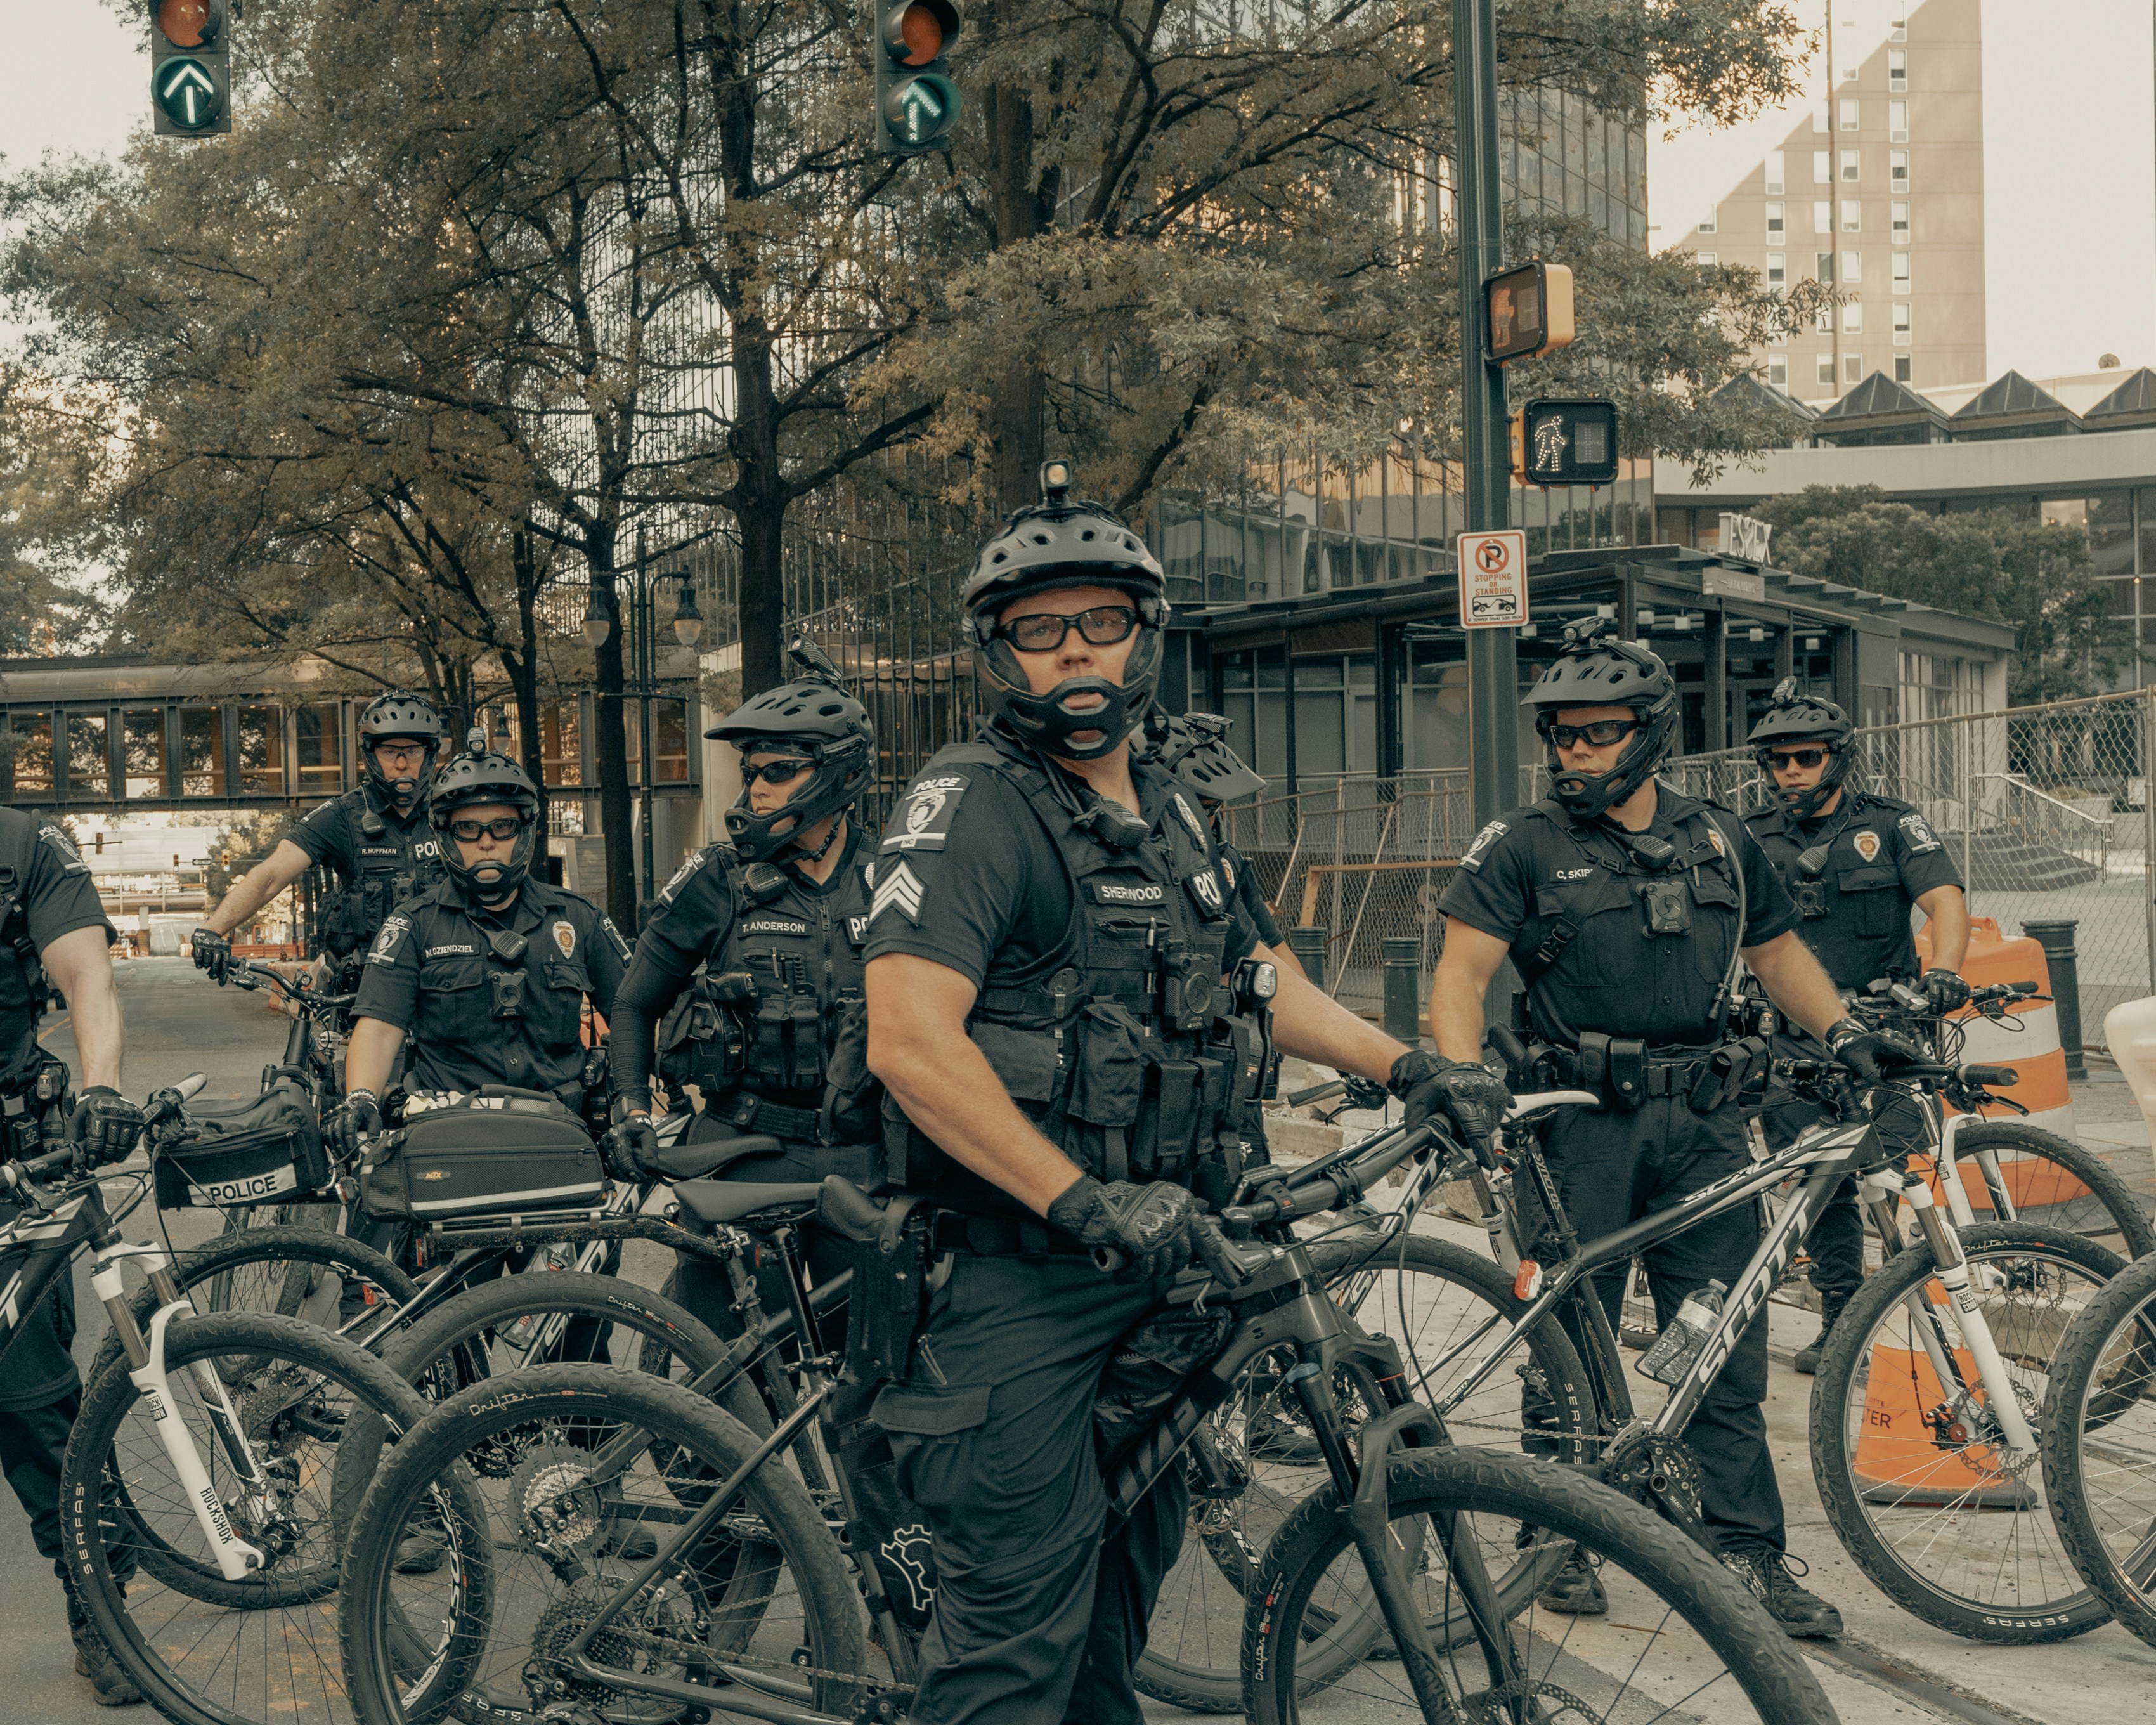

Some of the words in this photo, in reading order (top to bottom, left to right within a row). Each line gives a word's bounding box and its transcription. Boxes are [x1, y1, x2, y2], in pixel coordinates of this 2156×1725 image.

[1474, 573, 1512, 582] STOPPING
[1476, 587, 1512, 596] STANDING
[912, 778, 961, 794] POLICE
[1557, 870, 1567, 880] C.
[1568, 868, 1594, 879] SKIP
[1101, 885, 1162, 901] SHERWOOD
[209, 1175, 278, 1201] POLICE
[1534, 1152, 1561, 1211] SYNCROS
[608, 1296, 642, 1313] Drifter
[1698, 1196, 1808, 1395] SCOTT
[469, 1394, 534, 1416] Drifter
[1864, 1408, 1891, 1429] TER
[200, 1487, 233, 1545] ROCKSHOX
[75, 1486, 93, 1575] SERFAS
[1986, 1615, 2069, 1627] SERFAS
[1255, 1636, 1268, 1681] Drifter
